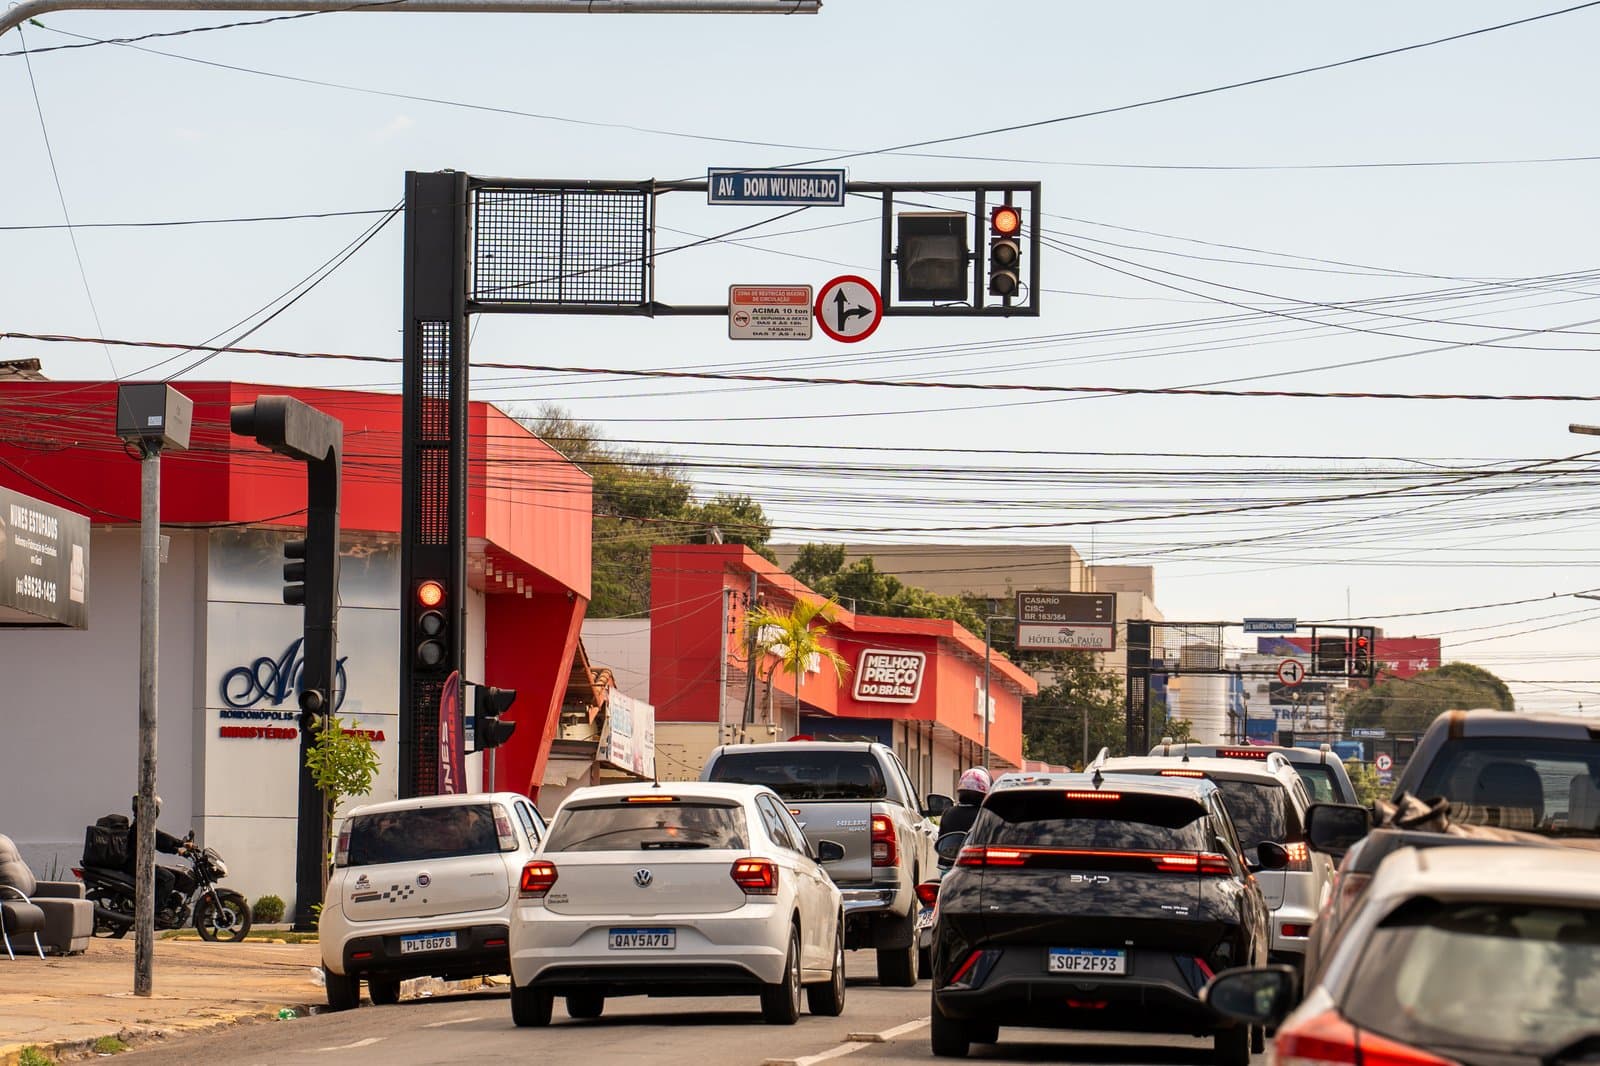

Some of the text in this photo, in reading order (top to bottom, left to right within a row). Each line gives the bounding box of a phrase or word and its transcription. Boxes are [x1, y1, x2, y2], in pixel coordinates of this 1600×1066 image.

[718, 178, 836, 198] AV. DOM WUNIBALDO
[10, 504, 58, 540] NUNES ESTOFADOS
[867, 656, 919, 670] MELHOR
[864, 668, 917, 685] PREÇO
[862, 684, 914, 696] DO BRASIL
[220, 708, 293, 720] RONDONÓPOLIS
[220, 724, 297, 740] MINISTÉRIO
[1070, 874, 1110, 884] BYD
[1056, 956, 1117, 971] SQF2F93
